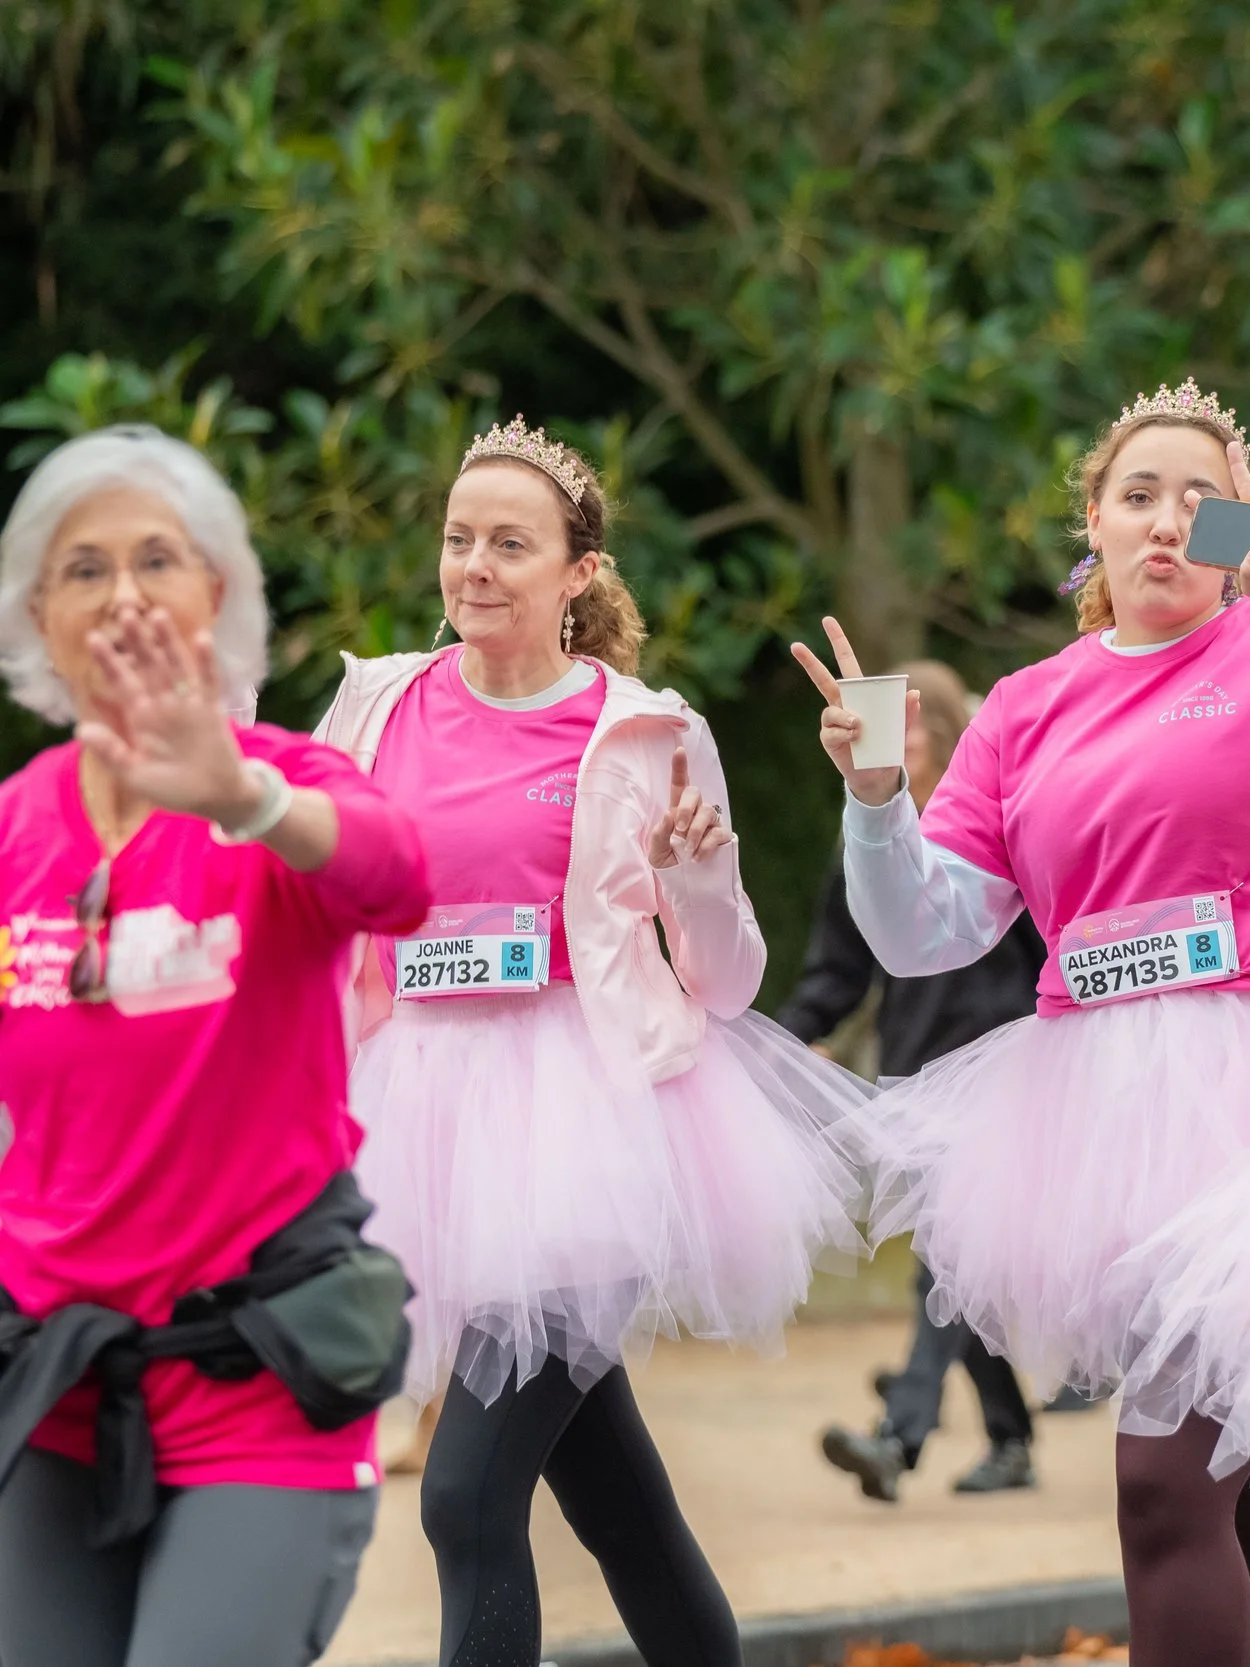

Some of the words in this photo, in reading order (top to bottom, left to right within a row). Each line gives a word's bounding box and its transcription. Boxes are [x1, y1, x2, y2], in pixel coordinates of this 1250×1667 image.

[1214, 686, 1229, 700] DAY
[1158, 701, 1237, 723] CLASSIC
[526, 787, 573, 808] CLAS
[416, 939, 474, 957] JOANNE
[510, 944, 526, 962] 8
[1067, 934, 1178, 971] ALEXANDRA
[1196, 934, 1211, 953] 8
[506, 965, 529, 977] KM
[1195, 955, 1217, 969] KM
[404, 959, 490, 988] 287132
[1073, 955, 1179, 999] 287135
